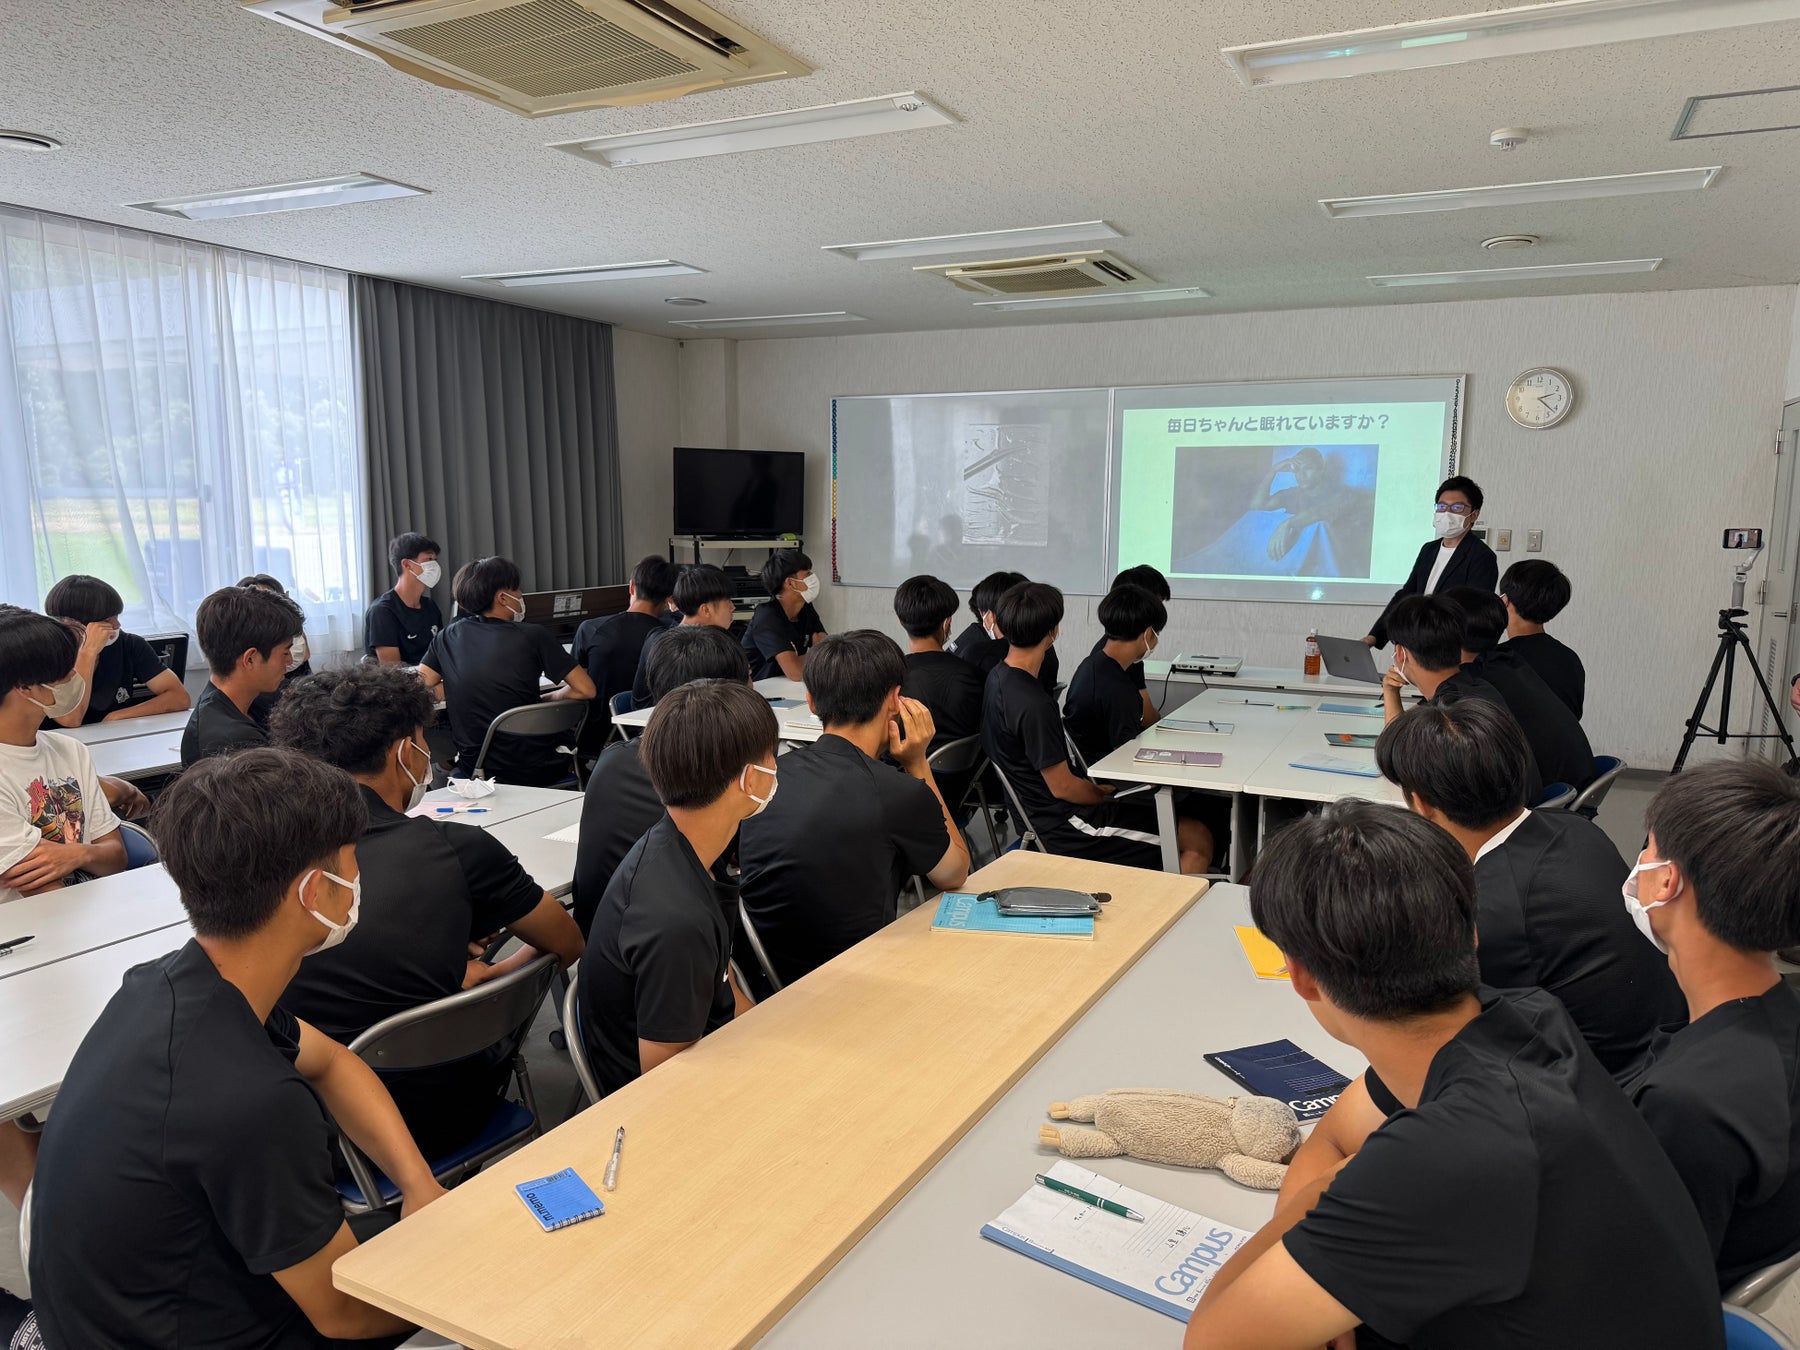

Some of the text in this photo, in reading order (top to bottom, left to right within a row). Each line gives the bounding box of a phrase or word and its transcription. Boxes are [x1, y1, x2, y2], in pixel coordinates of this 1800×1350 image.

[1167, 414, 1390, 433] 毎日ちゃんと眠れていますか？
[1154, 1227, 1233, 1296] Campus
